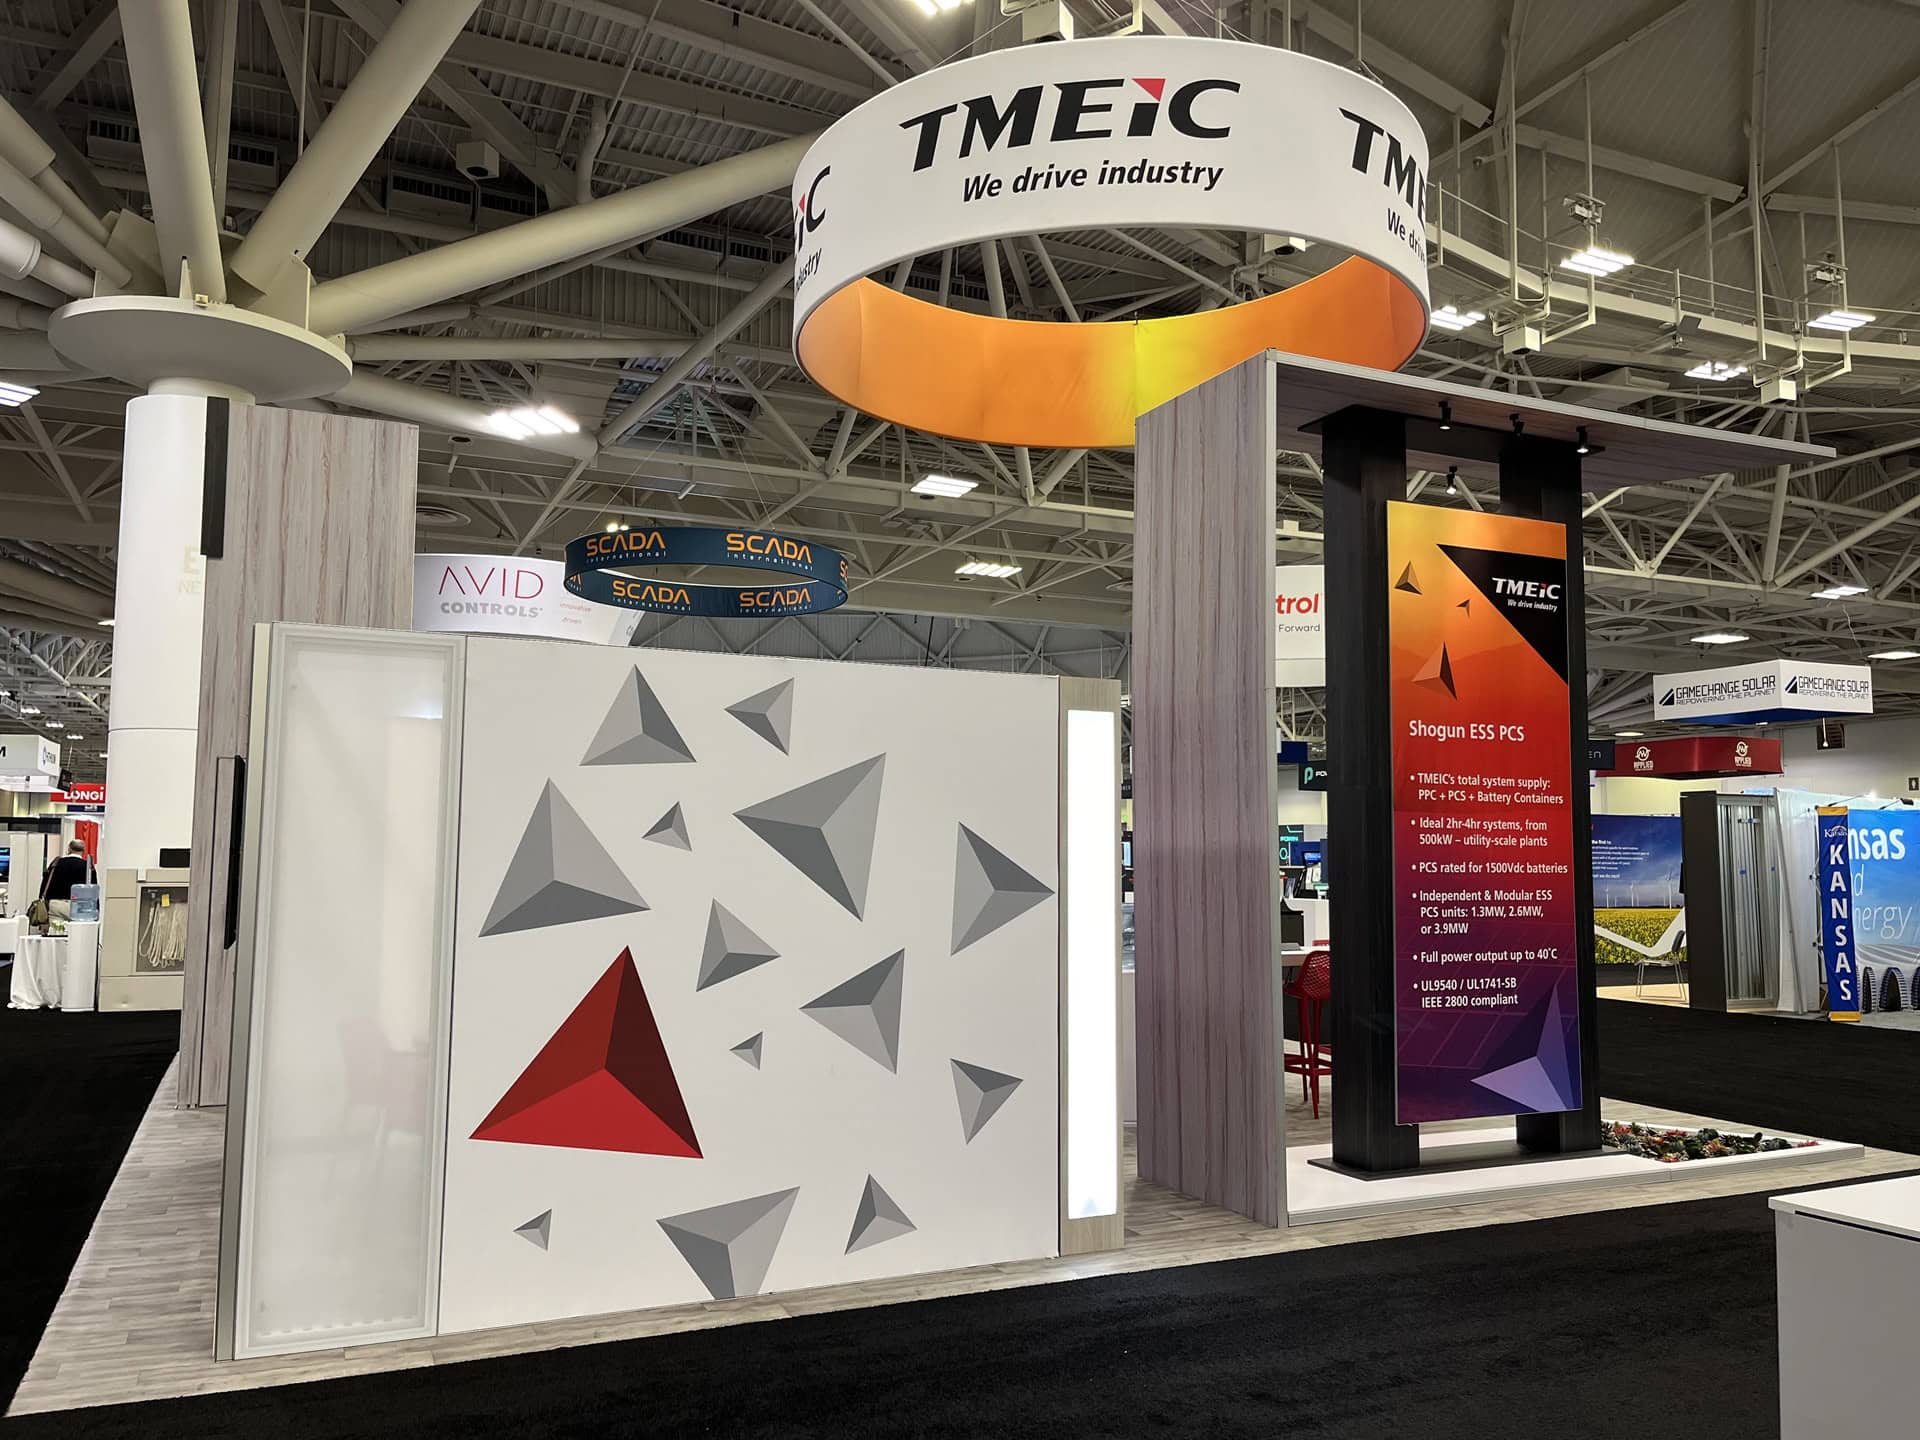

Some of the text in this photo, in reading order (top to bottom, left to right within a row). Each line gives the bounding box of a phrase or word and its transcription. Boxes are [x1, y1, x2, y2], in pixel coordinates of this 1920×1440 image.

[963, 159, 1224, 202] We drive industry
[1387, 207, 1406, 241] We
[586, 532, 666, 557] SCADA
[726, 533, 813, 564] SCADA
[586, 550, 667, 563] international
[727, 553, 813, 572] international
[438, 565, 544, 599] AVID
[612, 580, 691, 605] SCADA
[740, 588, 812, 607] SCADA
[613, 597, 691, 612] international
[1507, 599, 1558, 613] We drive industry
[1279, 623, 1321, 633] Forward
[1676, 675, 1776, 699] GAMECHANGE SOLAR
[1799, 676, 1869, 693] GAMECHANGE SOLAR
[1676, 687, 1776, 705] REPOWERING THE PLANET
[1409, 720, 1525, 742] Shogun ESS PCS
[1417, 772, 1551, 790] TMEIC's total system supply:
[1418, 789, 1564, 805] PPC + PCS + Battery Containers
[1419, 817, 1548, 832] Ideal 2hr-4hr systems, from
[1419, 833, 1453, 845] 500kW
[1463, 834, 1517, 848] utility-scale
[1519, 835, 1548, 848] plants
[1419, 862, 1568, 874] PCS rated for 1500Vdc batteries
[1419, 889, 1553, 904] Independent & Modular ESS
[1420, 905, 1544, 918] PCS units: 1.3MW, 2.6MW,
[1420, 922, 1469, 934] or 3.9MW
[1829, 844, 1852, 1001] KANSAS
[1420, 951, 1438, 963] Full
[1441, 953, 1472, 965] power
[1475, 950, 1508, 964] output
[1510, 951, 1523, 963] up
[1525, 951, 1535, 960] to
[1421, 977, 1517, 992] UL9540 / UL1741-SB
[1422, 993, 1518, 1009] IEEE 2800 compliant
